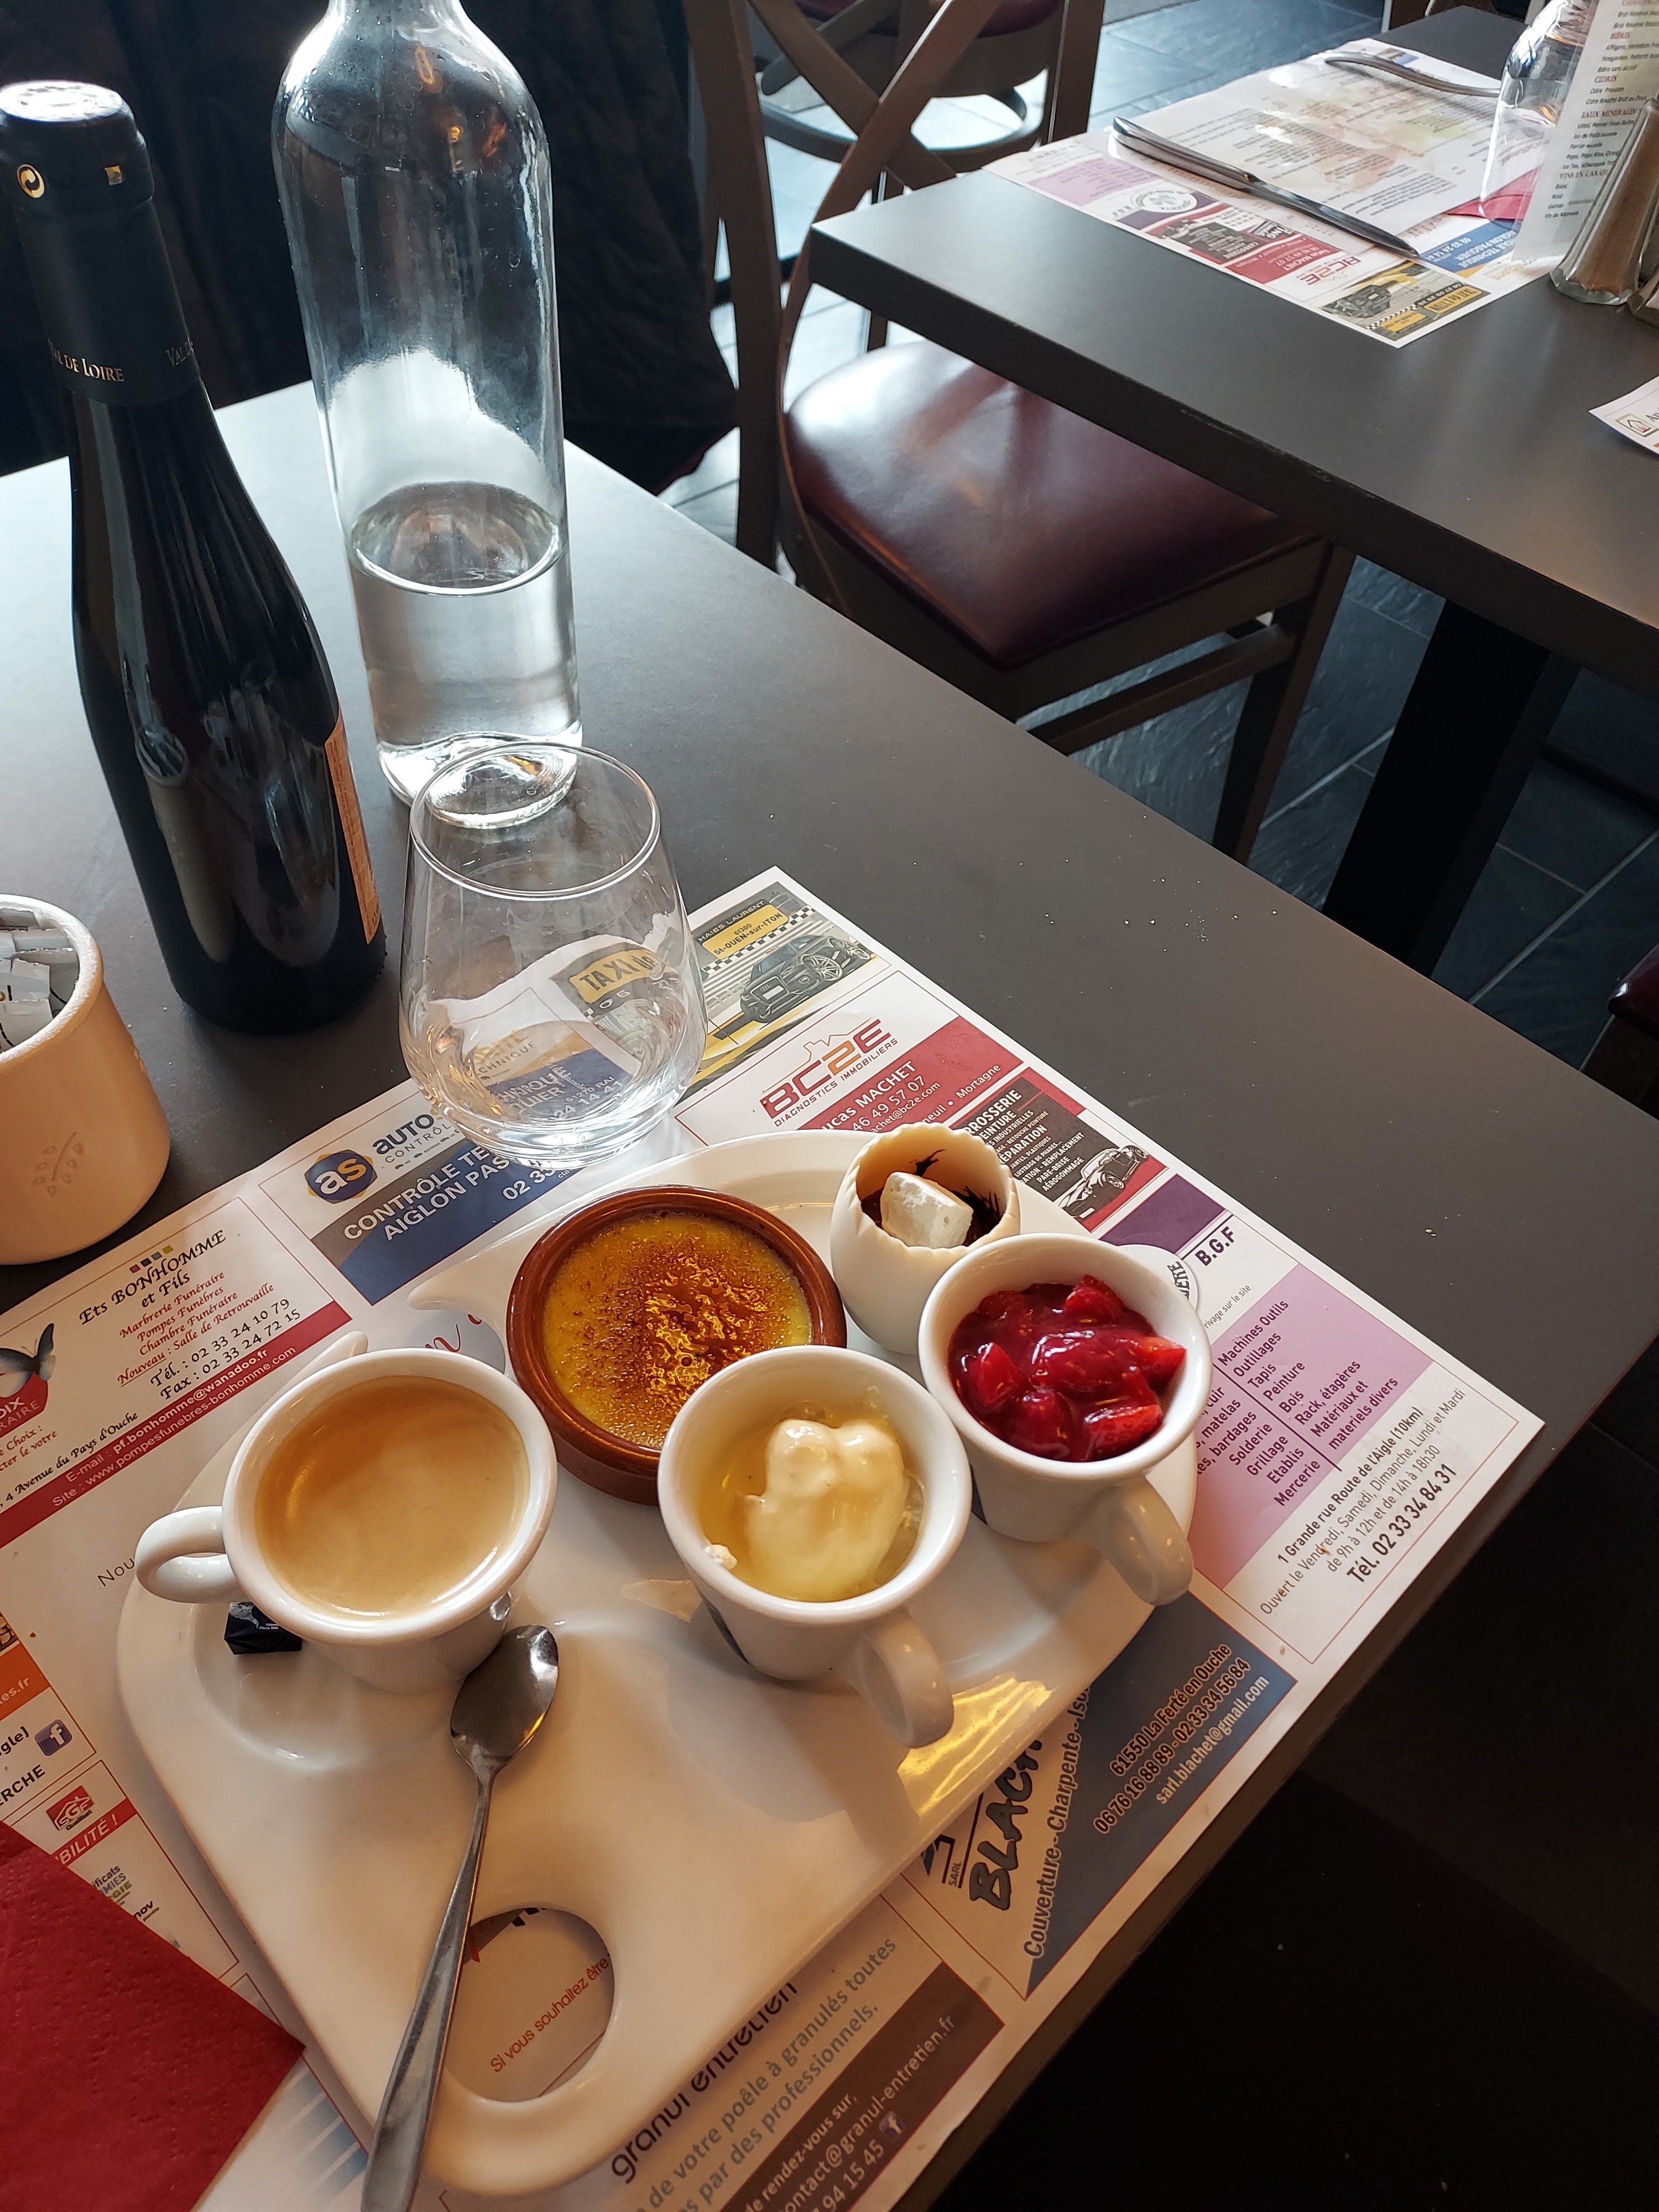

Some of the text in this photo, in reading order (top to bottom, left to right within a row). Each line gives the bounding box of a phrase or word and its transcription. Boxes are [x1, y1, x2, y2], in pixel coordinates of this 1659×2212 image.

[64, 354, 124, 382] DE LOIRE
[726, 900, 764, 925] LAURENT
[734, 924, 753, 936] 61300
[759, 1019, 891, 1120] BC2E
[774, 1037, 899, 1128] DIAGNOSTICS IMMOBILIERS
[854, 1060, 917, 1109] MACHET
[955, 1063, 1002, 1099] Mortagne
[871, 1074, 926, 1120] 49 57 07
[964, 1089, 1023, 1135] RROSSERIE
[385, 1124, 452, 1163] CONTRÔL
[1042, 1131, 1085, 1167] REMPLACEMENT
[502, 1180, 531, 1200] 02
[1036, 1155, 1071, 1183] PARE-BRISE
[1041, 1155, 1084, 1193] AÉROGOMMAGE
[343, 1163, 461, 1240] CONTRÔLE
[384, 1181, 467, 1241] AIGLON
[1194, 1225, 1235, 1267] B.G.F
[79, 1229, 227, 1325] Ets BONHOMME
[141, 1270, 191, 1308] et Fils
[1222, 1284, 1251, 1313] sur le site
[119, 1271, 225, 1339] Marbrerie Funéraire
[137, 1286, 225, 1343] Pompes Funèbres
[139, 1291, 238, 1356] Chambre Funéraire
[117, 1282, 275, 1386] Nouveau Salle de Retrouvaille
[160, 1308, 301, 1400] Fax 02 33 24 72 15
[190, 1298, 290, 1363] 02 33 24 10 79
[1217, 1300, 1289, 1366] Machines Outils
[1233, 1332, 1282, 1377] Outillages
[1247, 1363, 1276, 1389] Tapis
[1262, 1361, 1306, 1401] Peinture
[1294, 1360, 1361, 1426] Rack, étagères
[65, 1348, 269, 1483] E-mail pf.bonhomme@wanadoo.fr
[1201, 1399, 1241, 1439] matelas
[1279, 1390, 1304, 1413] Bois
[1310, 1380, 1369, 1437] Matériaux et
[1328, 1377, 1399, 1451] materiels divers
[6, 1428, 36, 1451] Choix
[6, 1412, 139, 1502] 4 Avenue du Pays d'Ouche
[19, 1431, 58, 1457] le votre
[1208, 1411, 1257, 1457] bardages
[1229, 1423, 1272, 1465] Solderie
[1246, 1435, 1288, 1476] Grillage
[1266, 1447, 1304, 1484] Etablis
[1273, 1458, 1321, 1506] Mercerie
[1285, 1406, 1424, 1557] Grande rue Route de l'Aigle (10km)
[53, 1487, 77, 1507] Site
[1260, 1387, 1467, 1615] Ouvert le Samedi, Dimanche, Lundi et Mardi
[1327, 1443, 1441, 1572] de 9h à 12h et de 14h à 18h30
[1346, 1462, 1458, 1584] Tél. 02 33 34 84 31
[97, 1558, 135, 1587] Nou
[1111, 1644, 1230, 1776] 61550 La Ferté en Ouche
[1094, 1657, 1251, 1833] 06 76 16 88 89 02 33 34 56 84
[1156, 1676, 1270, 1804] sarl.blachet@gmail.com
[1024, 1730, 1082, 1958] Couverture Charpente
[948, 1861, 962, 1887] SARL
[491, 1978, 589, 2072] Si vous souhaitez
[649, 2179, 675, 2209] de
[673, 2126, 721, 2179] votre
[721, 2074, 770, 2133] poêle
[765, 2059, 782, 2078] à
[781, 1990, 848, 2067] granulés
[844, 1939, 896, 1991] toutes
[699, 2005, 879, 2205] par des professionnels.
[762, 2093, 858, 2203] rendez-vous sur,
[843, 2138, 884, 2190] 15 45
